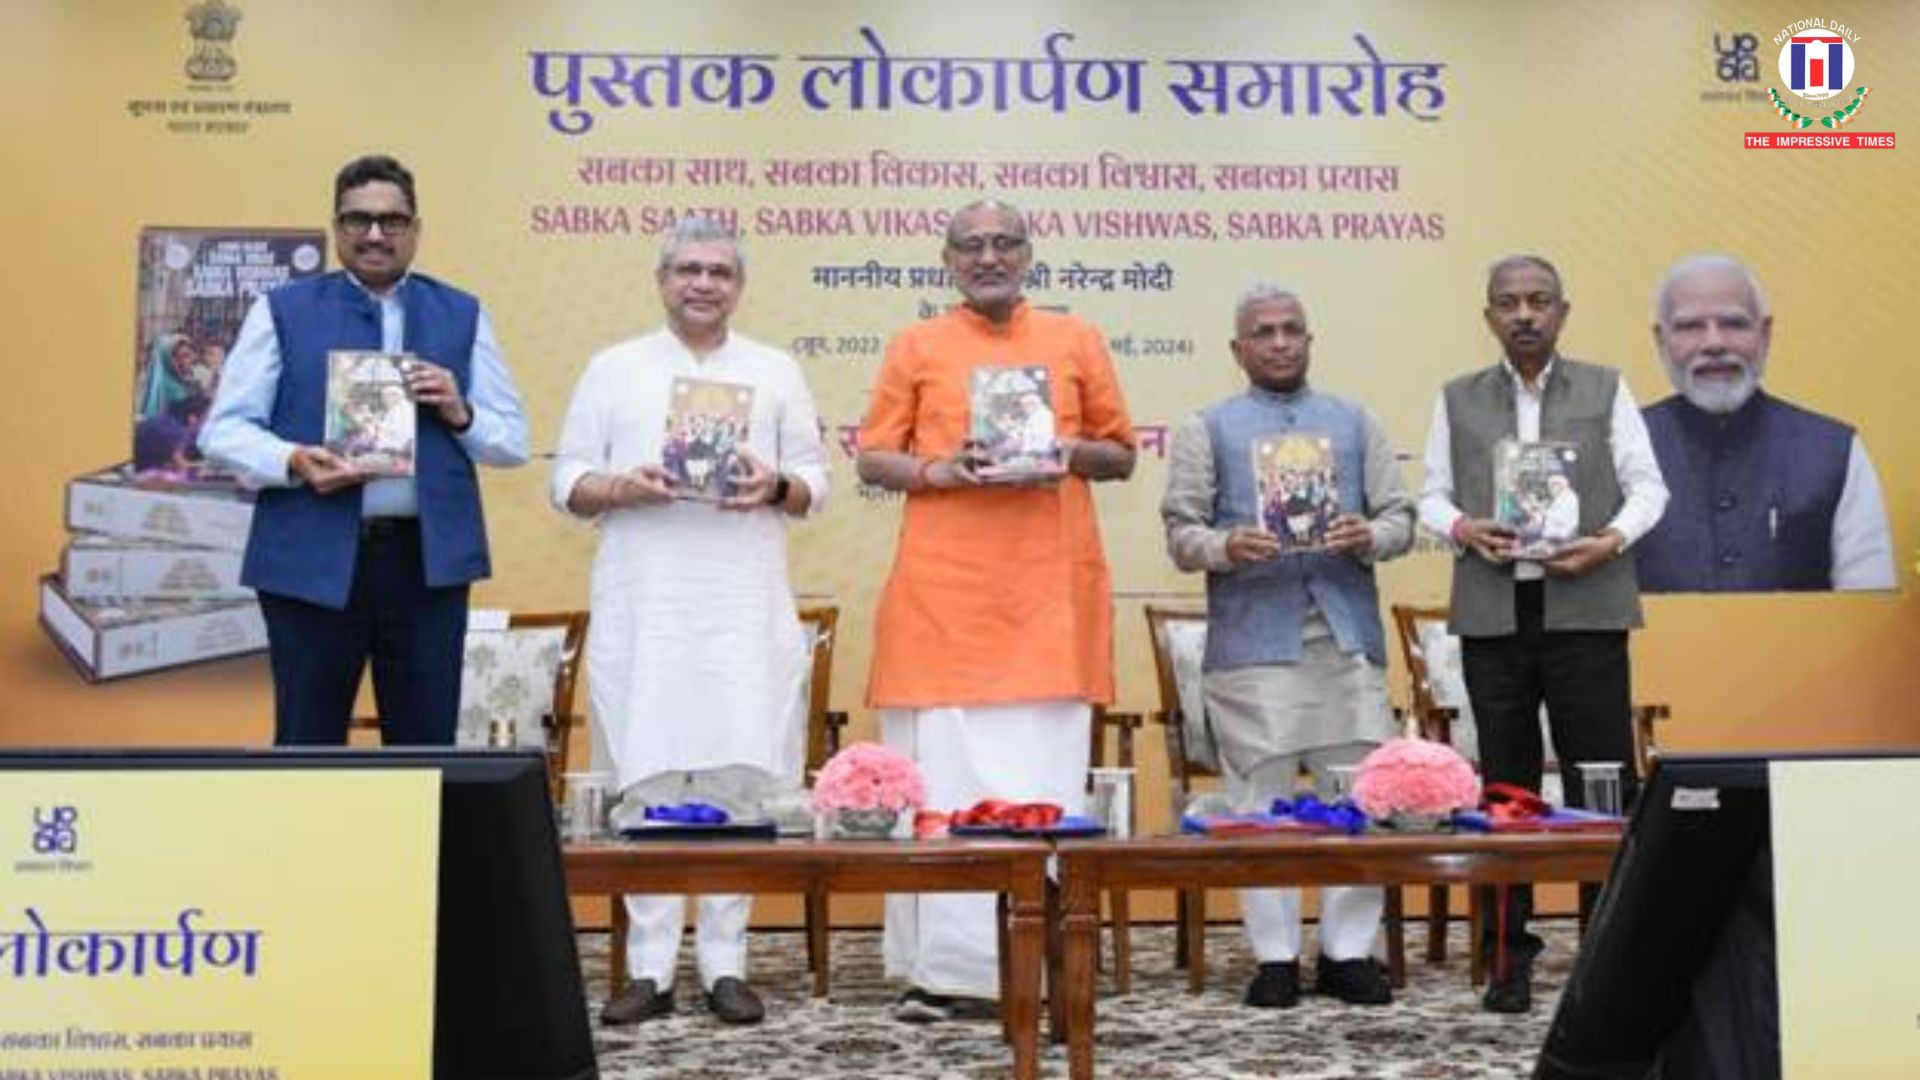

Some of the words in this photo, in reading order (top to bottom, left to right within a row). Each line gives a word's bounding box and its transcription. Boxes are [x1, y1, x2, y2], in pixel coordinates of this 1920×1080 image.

[528, 50, 780, 136] पुस्तक
[797, 26, 1148, 115] लोकार्पण
[1166, 33, 1447, 121] समारोह
[577, 157, 675, 187] सबका
[685, 157, 756, 189] साथ,
[764, 157, 860, 188] सबका
[870, 149, 985, 190] विकास,
[993, 161, 1089, 191] सबका
[1098, 152, 1205, 193] विश्वास,
[1213, 162, 1307, 192] सबका
[1317, 162, 1401, 193] प्रयास
[530, 206, 631, 235] SABKA
[755, 208, 854, 237] SABKA
[1073, 210, 1218, 241] VISHWAS,
[1227, 212, 1323, 240] SABKA
[1332, 212, 1446, 241] PRAYAS
[811, 260, 902, 288] माननीय
[1121, 260, 1174, 291] मोदी
